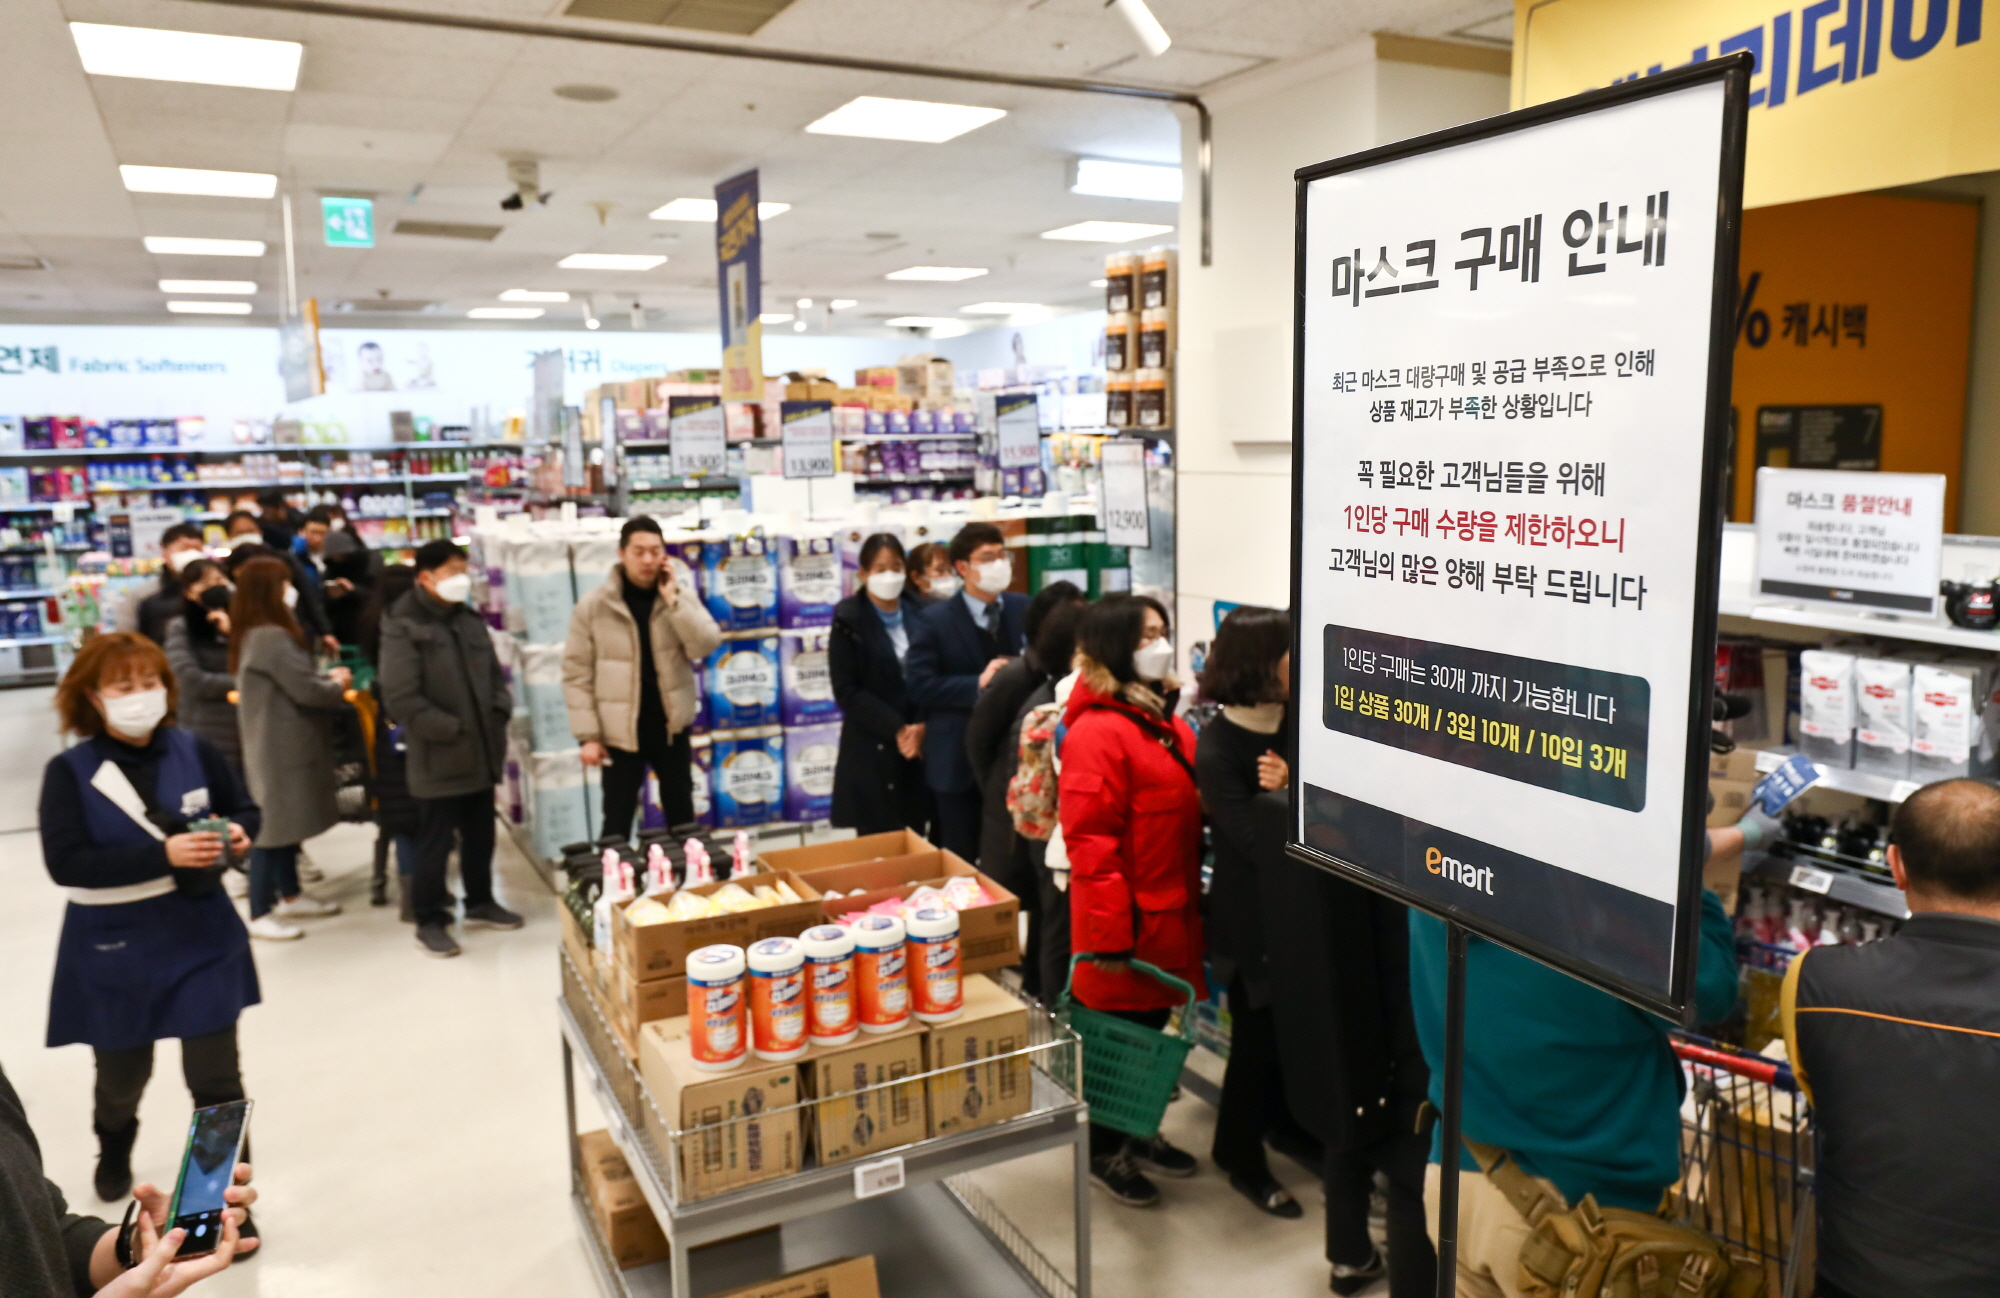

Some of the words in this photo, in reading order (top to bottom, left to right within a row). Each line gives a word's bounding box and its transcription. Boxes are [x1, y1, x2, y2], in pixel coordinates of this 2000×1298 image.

[1332, 240, 1439, 307] 마스크
[1455, 214, 1542, 291] 구매
[1563, 191, 1668, 277] 안내
[1782, 302, 1867, 347] 캐시백
[0, 345, 60, 373] 연제
[69, 357, 128, 373] Fabric
[1333, 372, 1357, 393] 최근
[1362, 369, 1401, 391] 마스크
[1407, 363, 1464, 388] 대량구매
[1472, 361, 1485, 385] 및
[1493, 359, 1526, 384] 공급
[1533, 355, 1606, 382] 부족으로
[1615, 349, 1654, 377] 인해
[1370, 400, 1396, 423] 상품
[1400, 398, 1444, 421] 재고가
[1449, 395, 1497, 420] 부족한
[1503, 391, 1592, 419] 상황입니다
[1358, 461, 1374, 488] 꼭
[1380, 460, 1434, 490] 필요한
[1441, 461, 1548, 494] 고객님들을
[1557, 462, 1605, 497] 위해
[1108, 510, 1145, 530] 12,900
[1786, 492, 1835, 510] 마스크
[1842, 493, 1913, 516] 품절안내
[1345, 506, 1388, 534] 1인당
[1393, 508, 1428, 537] 구매
[1436, 510, 1498, 542] 수량을
[1505, 514, 1624, 552] 제한하오니
[1329, 549, 1394, 581] 고객님의
[1402, 554, 1438, 585] 많은
[1446, 559, 1484, 592] 양해
[1492, 563, 1537, 598] 부탁
[1544, 570, 1647, 610] 드립니다
[1343, 647, 1376, 674] 1인당
[1380, 654, 1426, 685] 구매는
[1431, 665, 1465, 693] 30개
[1471, 672, 1506, 702] 까지
[1512, 680, 1616, 724] 가능합니다
[1335, 685, 1354, 711] 1입
[1359, 691, 1390, 720] 상품
[1394, 699, 1430, 730] 30개
[1435, 709, 1442, 731] /
[1447, 712, 1476, 742] 3입
[1482, 719, 1520, 752] 10개
[1526, 730, 1536, 754] /
[1541, 732, 1583, 768] 10입
[1591, 744, 1627, 779] 3개
[1426, 847, 1494, 895] emart
